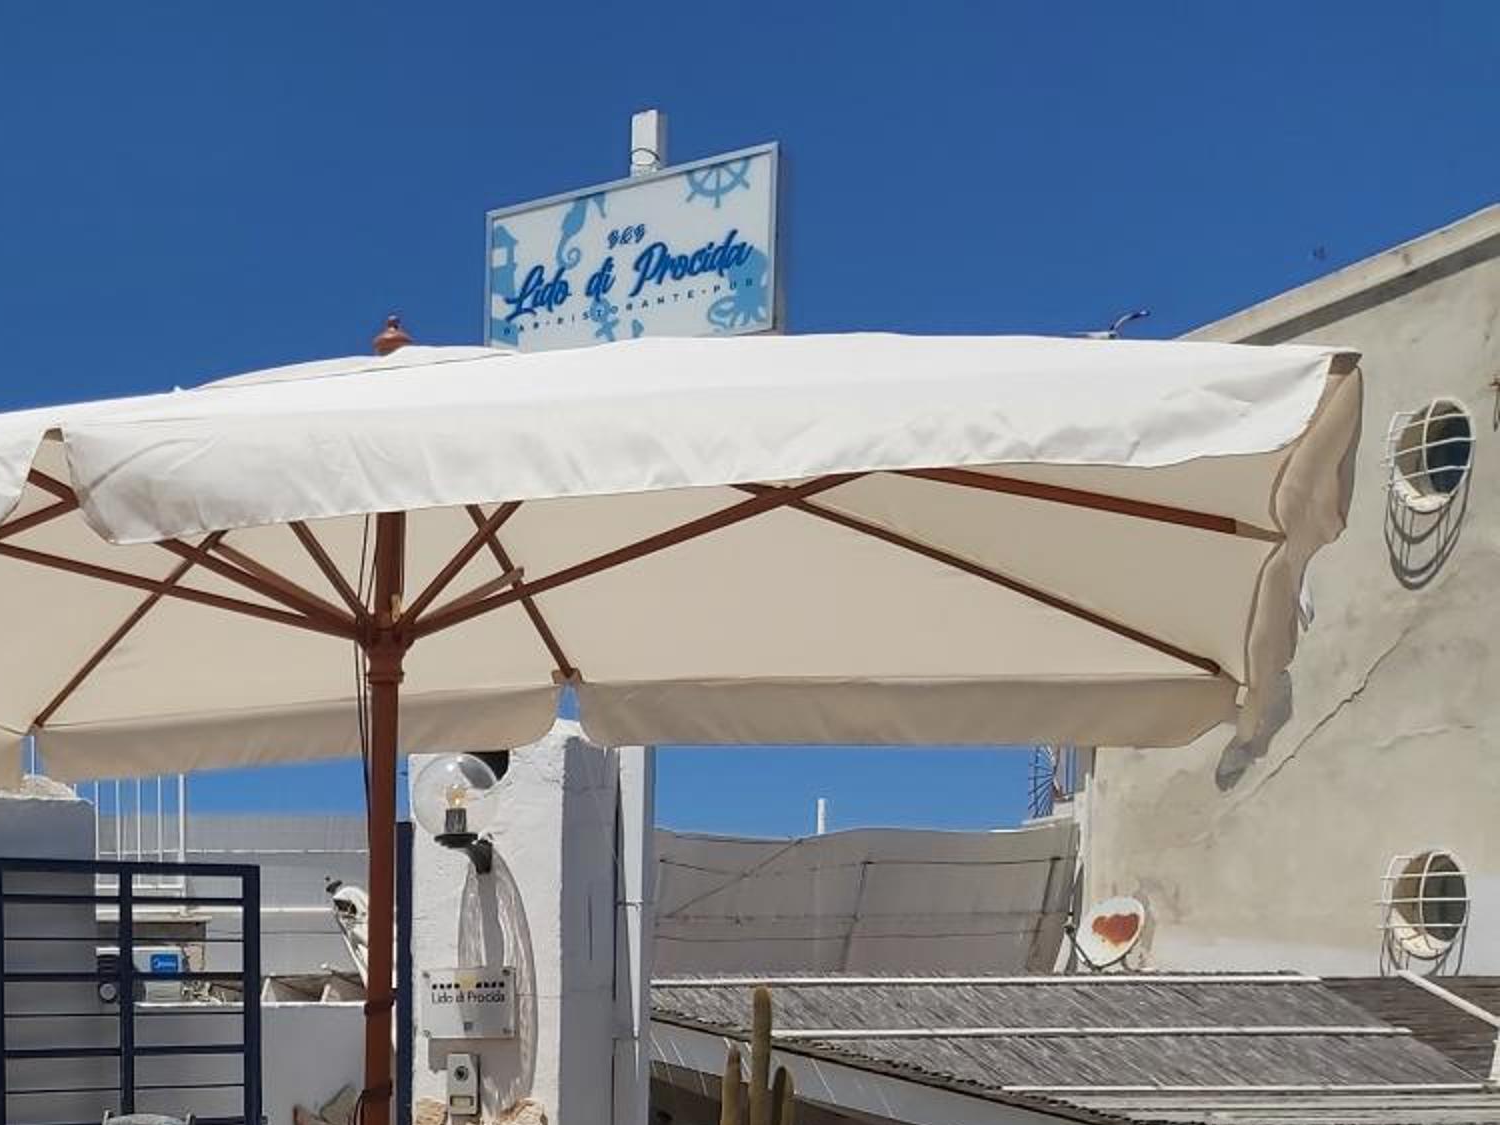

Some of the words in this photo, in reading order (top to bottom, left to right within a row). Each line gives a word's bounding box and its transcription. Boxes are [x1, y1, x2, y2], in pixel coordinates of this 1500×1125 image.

[504, 264, 572, 322] Lido
[584, 256, 616, 303] di
[627, 228, 754, 298] Procida
[431, 990, 453, 1004] Lido
[467, 989, 506, 1003] Procida
